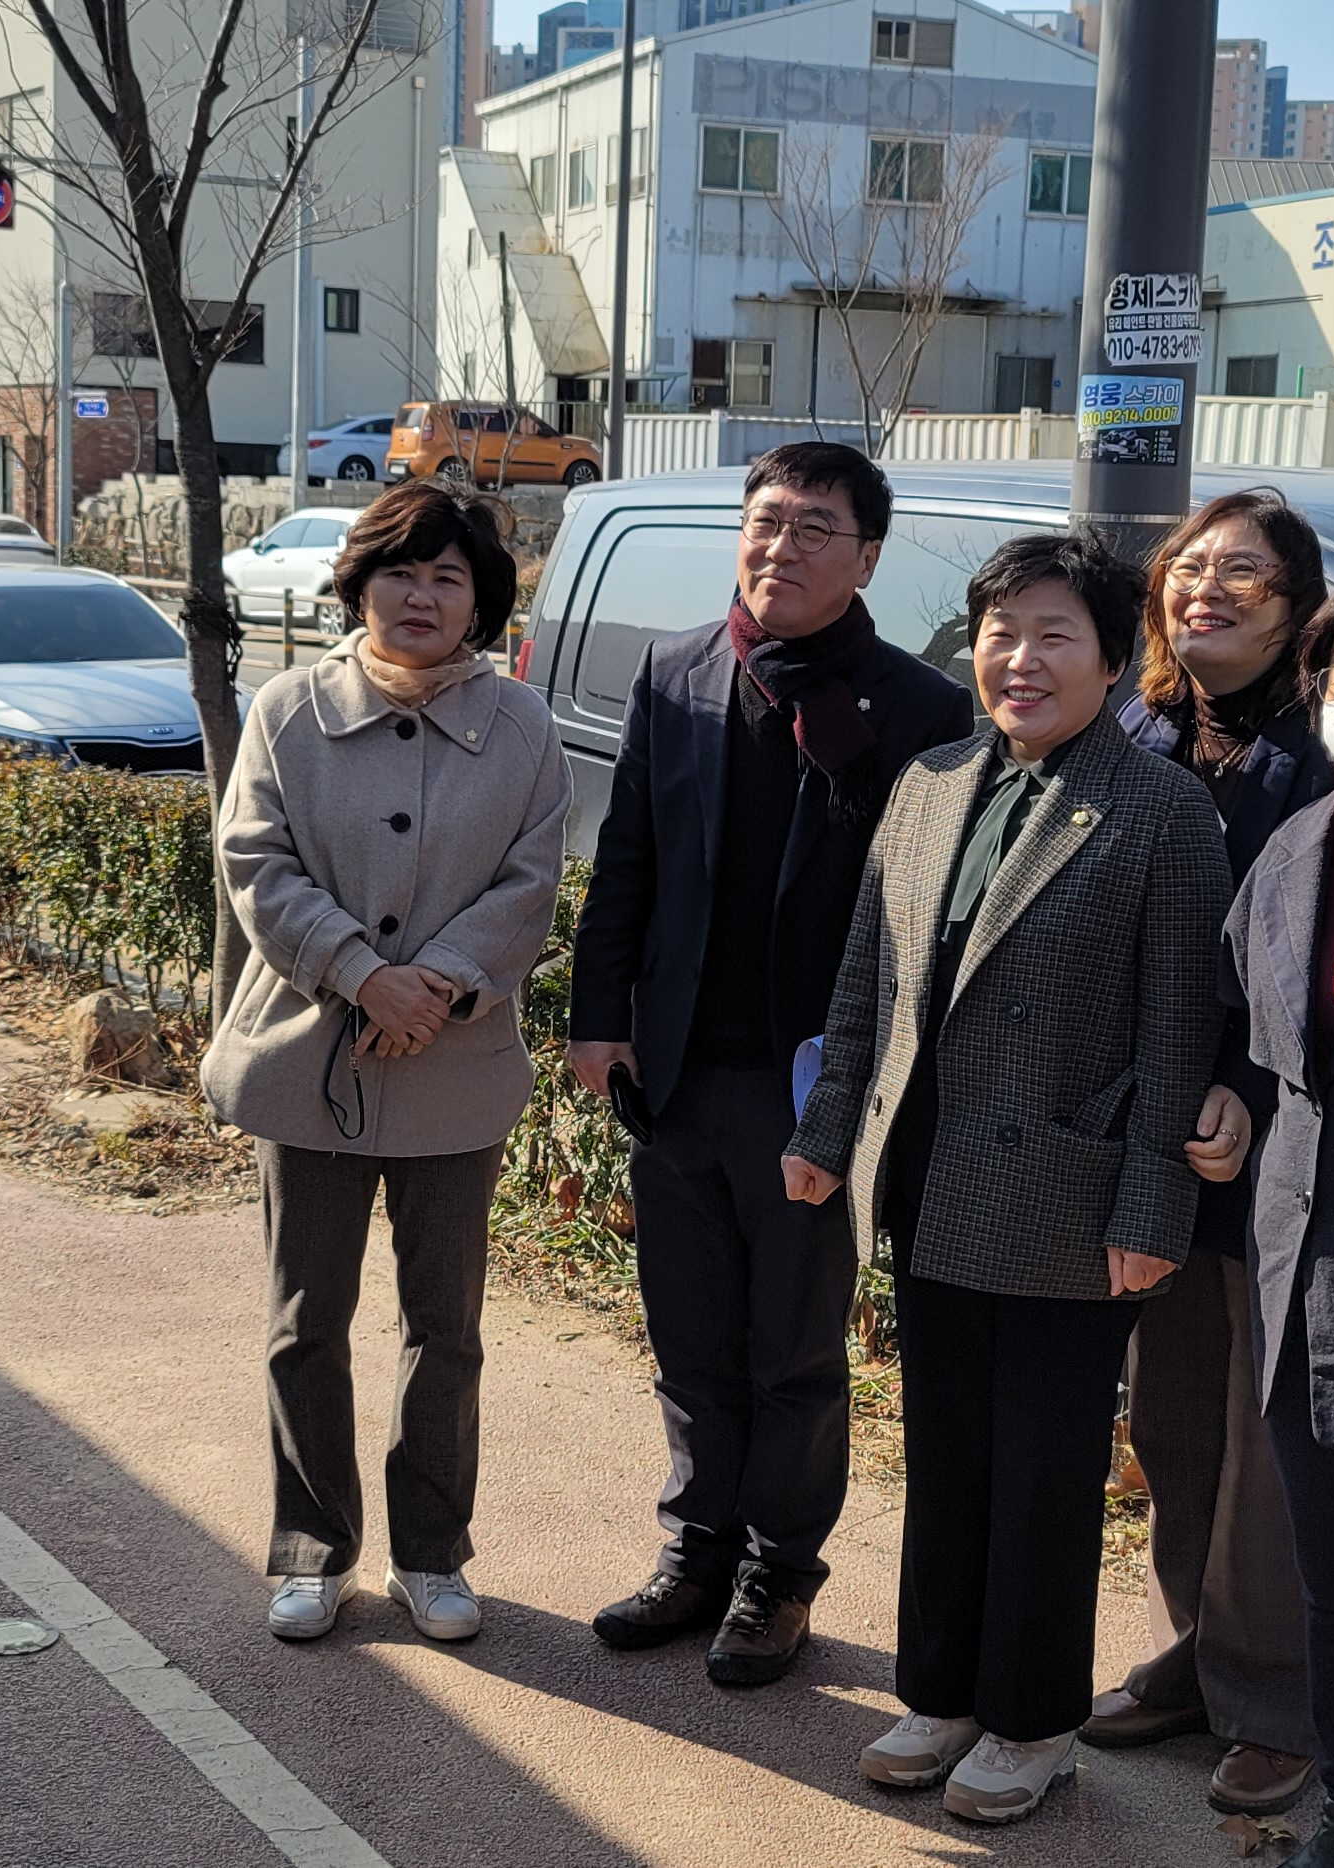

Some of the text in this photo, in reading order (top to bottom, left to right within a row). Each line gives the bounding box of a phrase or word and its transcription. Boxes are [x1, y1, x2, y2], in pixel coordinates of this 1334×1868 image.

[700, 57, 948, 125] PISCO
[1084, 382, 1180, 408] 영웅 스카이
